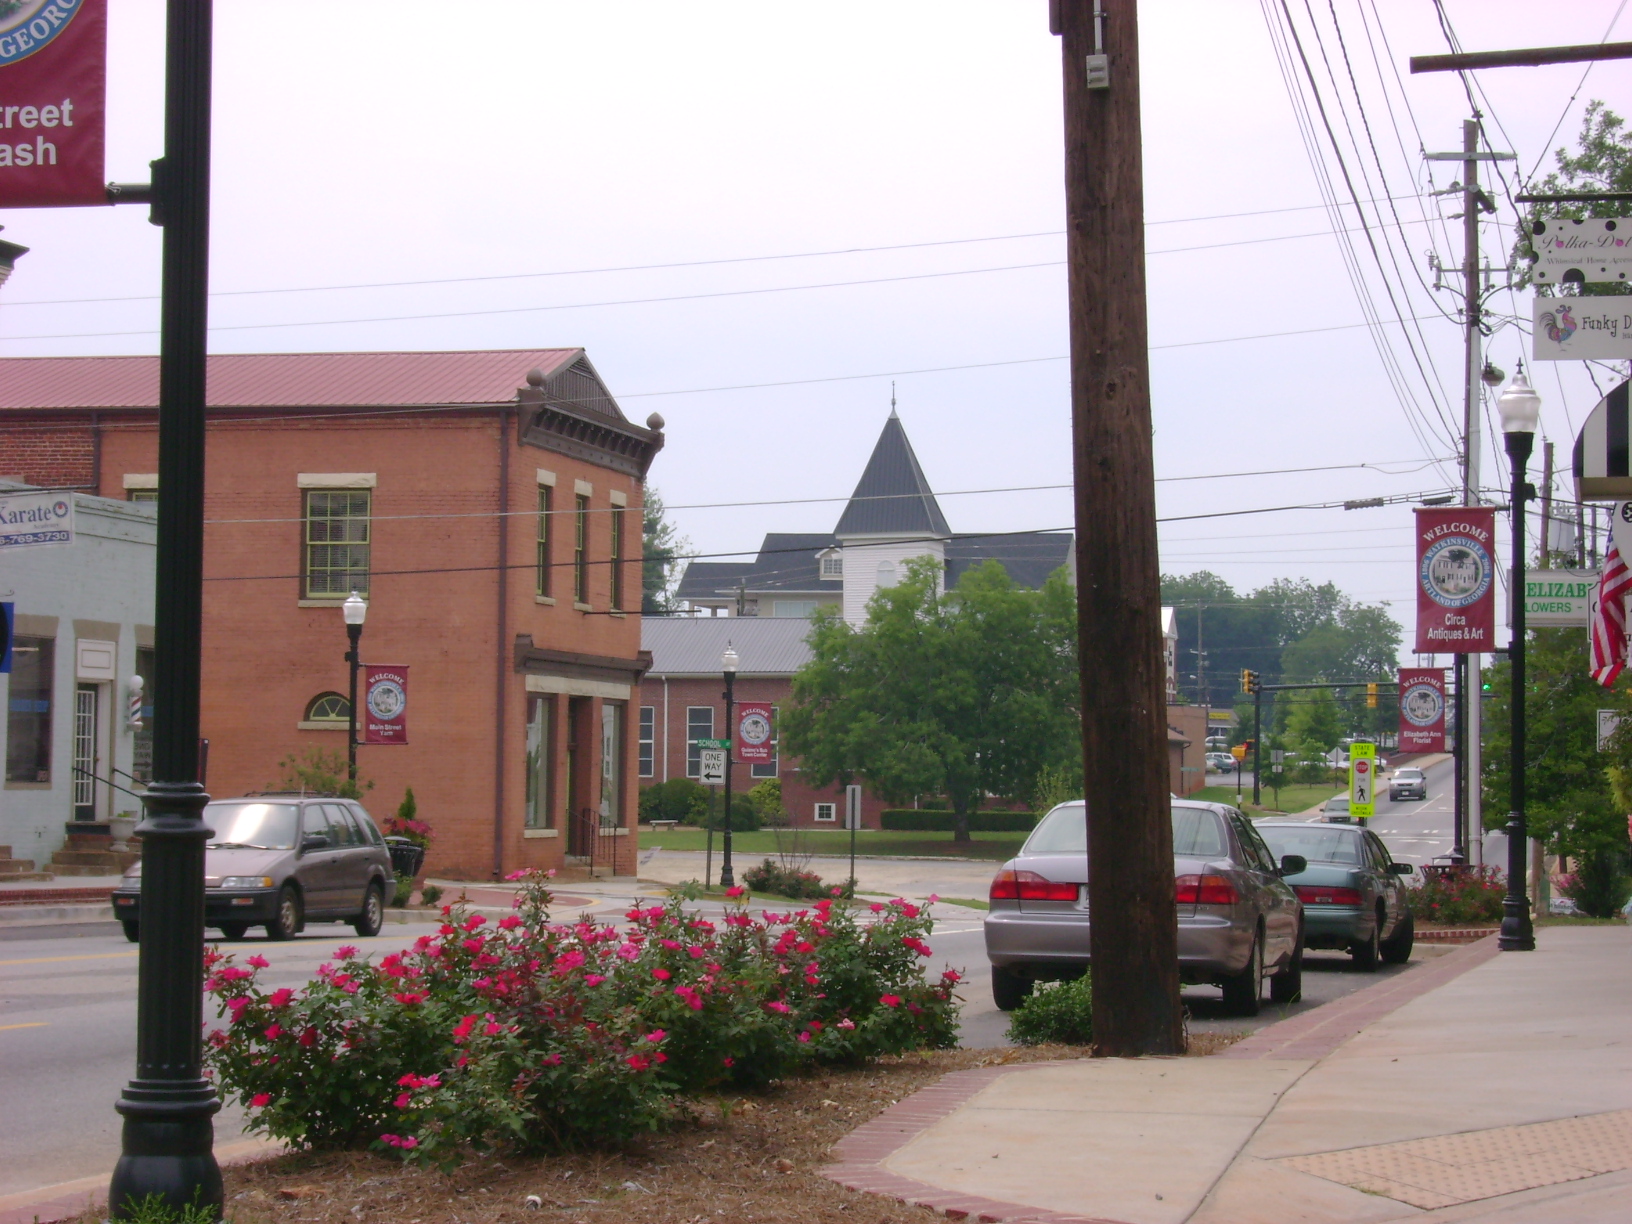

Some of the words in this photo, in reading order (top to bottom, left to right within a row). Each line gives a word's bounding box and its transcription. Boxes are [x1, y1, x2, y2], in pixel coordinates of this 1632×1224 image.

[0, 135, 57, 167] ash
[1582, 314, 1618, 338] Funky
[0, 504, 52, 524] Karate
[1423, 522, 1489, 543] WELCOME
[1426, 537, 1485, 558] WATKINSVILLE
[1421, 579, 1452, 606] ARTLAND
[1461, 578, 1490, 606] GEORGIA
[1526, 583, 1593, 598] ELIZAB
[1445, 613, 1466, 626] Circa
[1427, 627, 1462, 642] Antiques
[1464, 628, 1470, 640] &
[1470, 628, 1484, 640] Art
[368, 672, 405, 685] WELCOME
[1403, 676, 1442, 688] WELCOME
[741, 708, 769, 717] WELCOME
[697, 740, 722, 748] SCHOOL
[704, 753, 722, 761] ONE
